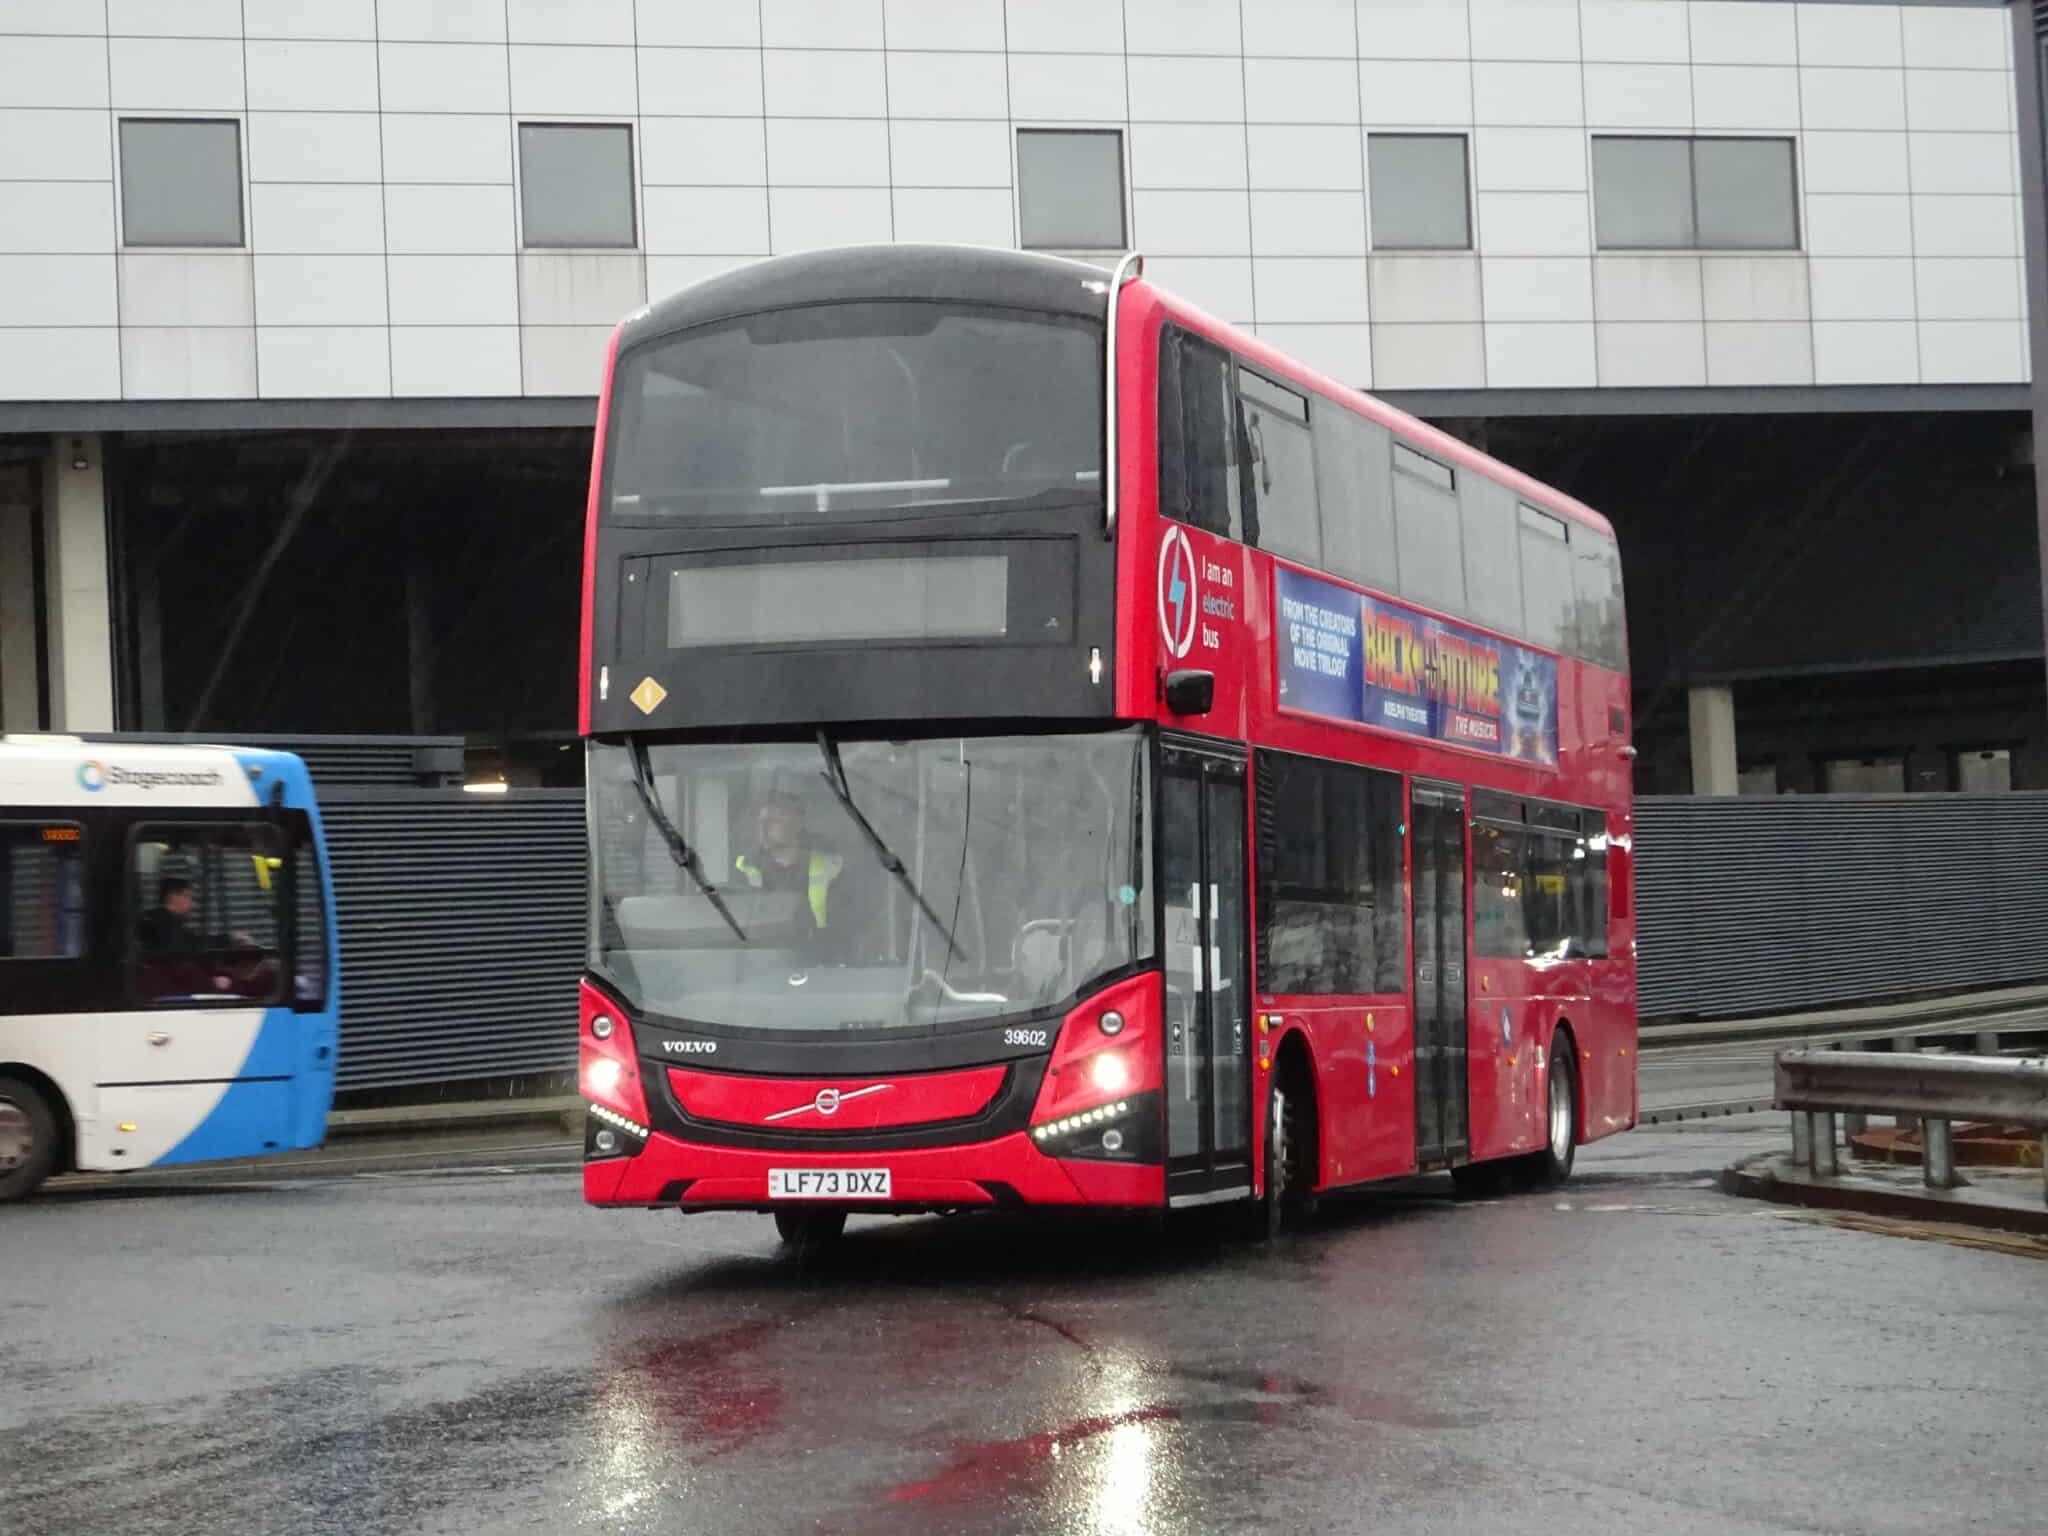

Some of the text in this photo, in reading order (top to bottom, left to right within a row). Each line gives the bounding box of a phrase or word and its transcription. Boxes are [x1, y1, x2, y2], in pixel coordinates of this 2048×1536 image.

[1208, 562, 1221, 584] am
[1222, 567, 1233, 587] an
[1202, 588, 1235, 620] electric
[1282, 597, 1356, 637] FROM THE CREATORS
[1202, 621, 1220, 649] bus
[1289, 622, 1350, 657] OF THE ORIGINAL
[1293, 646, 1347, 678] MOVIE TRILOGY
[1362, 607, 1424, 696] BACK
[1437, 631, 1500, 716] FUTURE
[1455, 714, 1498, 741] THE MUSICAL
[106, 765, 223, 790] Stagecoach
[662, 1040, 717, 1054] VOLVO
[1003, 1028, 1047, 1047] 39602
[784, 1172, 887, 1193] LF73 DXZ
